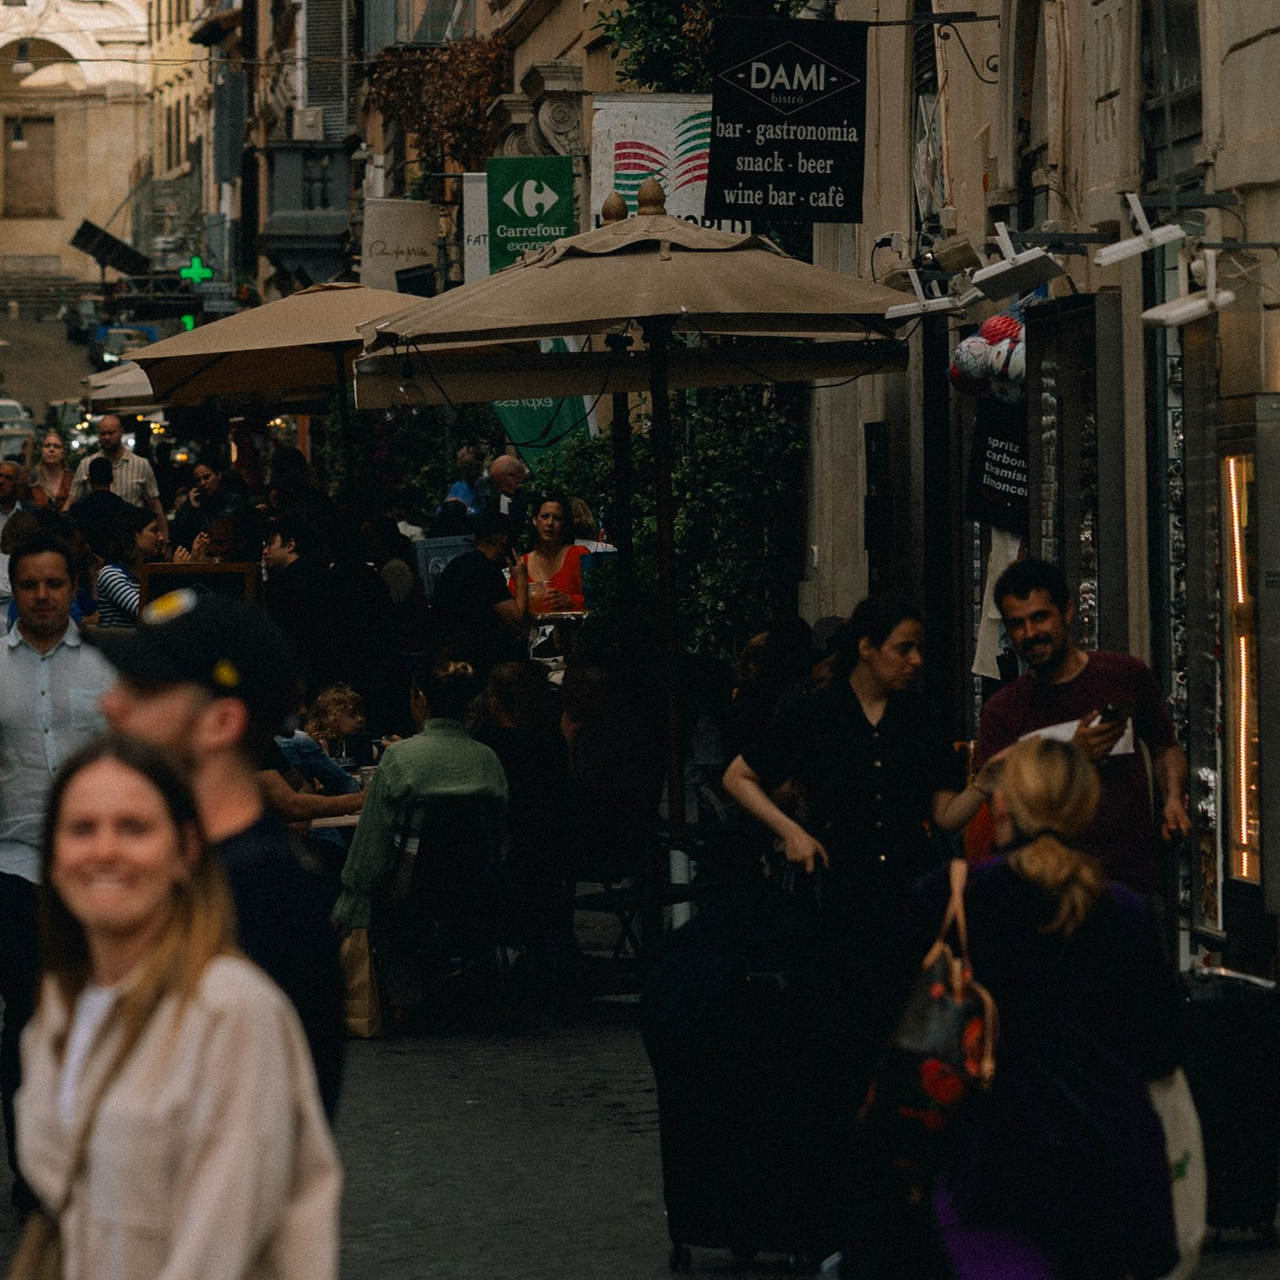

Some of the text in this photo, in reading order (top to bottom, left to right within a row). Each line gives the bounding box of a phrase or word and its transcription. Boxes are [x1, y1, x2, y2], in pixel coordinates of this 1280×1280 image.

[750, 61, 826, 92] DAMI
[716, 116, 744, 138] bar
[755, 119, 859, 146] gastronomia
[736, 150, 784, 172] snack
[797, 151, 834, 174] beer
[723, 181, 764, 205] wine
[768, 184, 796, 206] bar
[809, 185, 845, 208] cafè
[496, 223, 568, 238] Carrefour
[987, 436, 1020, 453] spritz
[985, 449, 1028, 469] carbon
